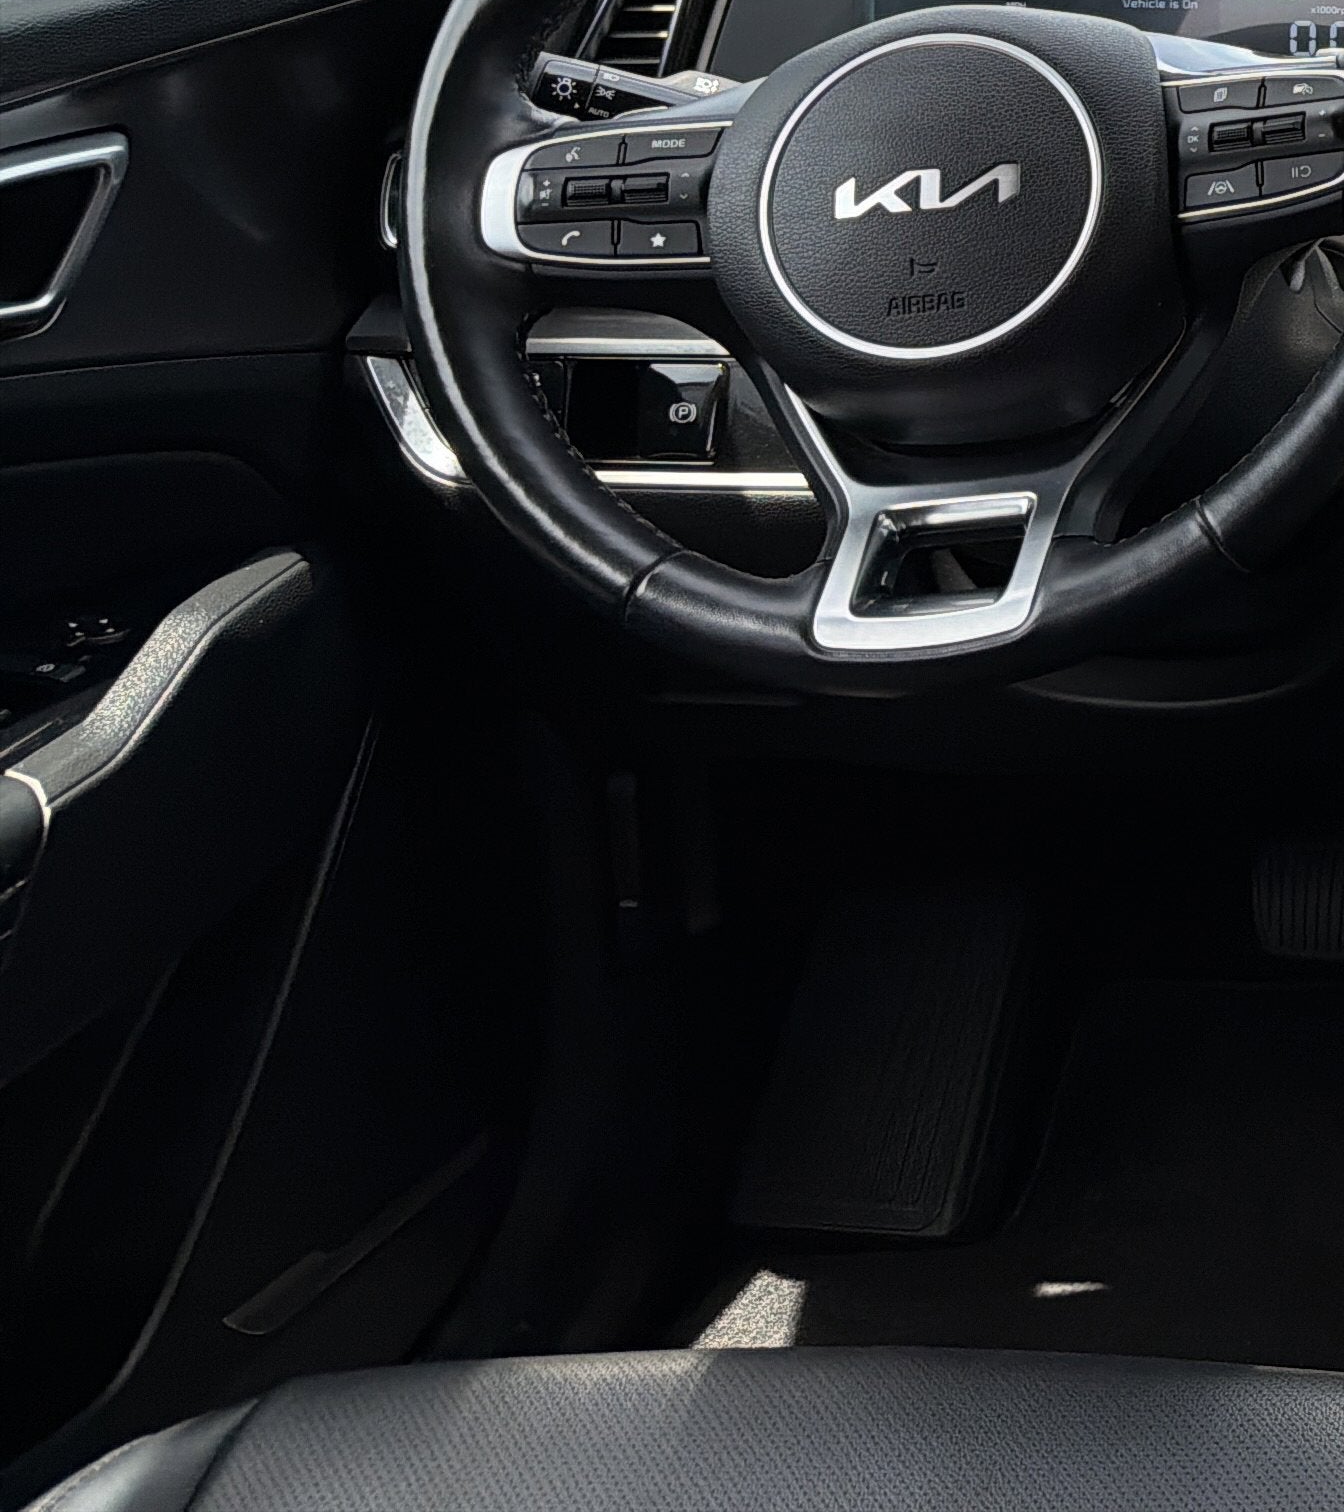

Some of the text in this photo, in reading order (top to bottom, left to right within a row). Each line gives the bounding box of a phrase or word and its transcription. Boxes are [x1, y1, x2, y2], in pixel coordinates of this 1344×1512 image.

[1182, 0, 1199, 10] On
[588, 106, 611, 119] AUTO
[651, 137, 687, 150] MODE
[1187, 135, 1200, 144] OK
[886, 290, 967, 317] AIRBAG
